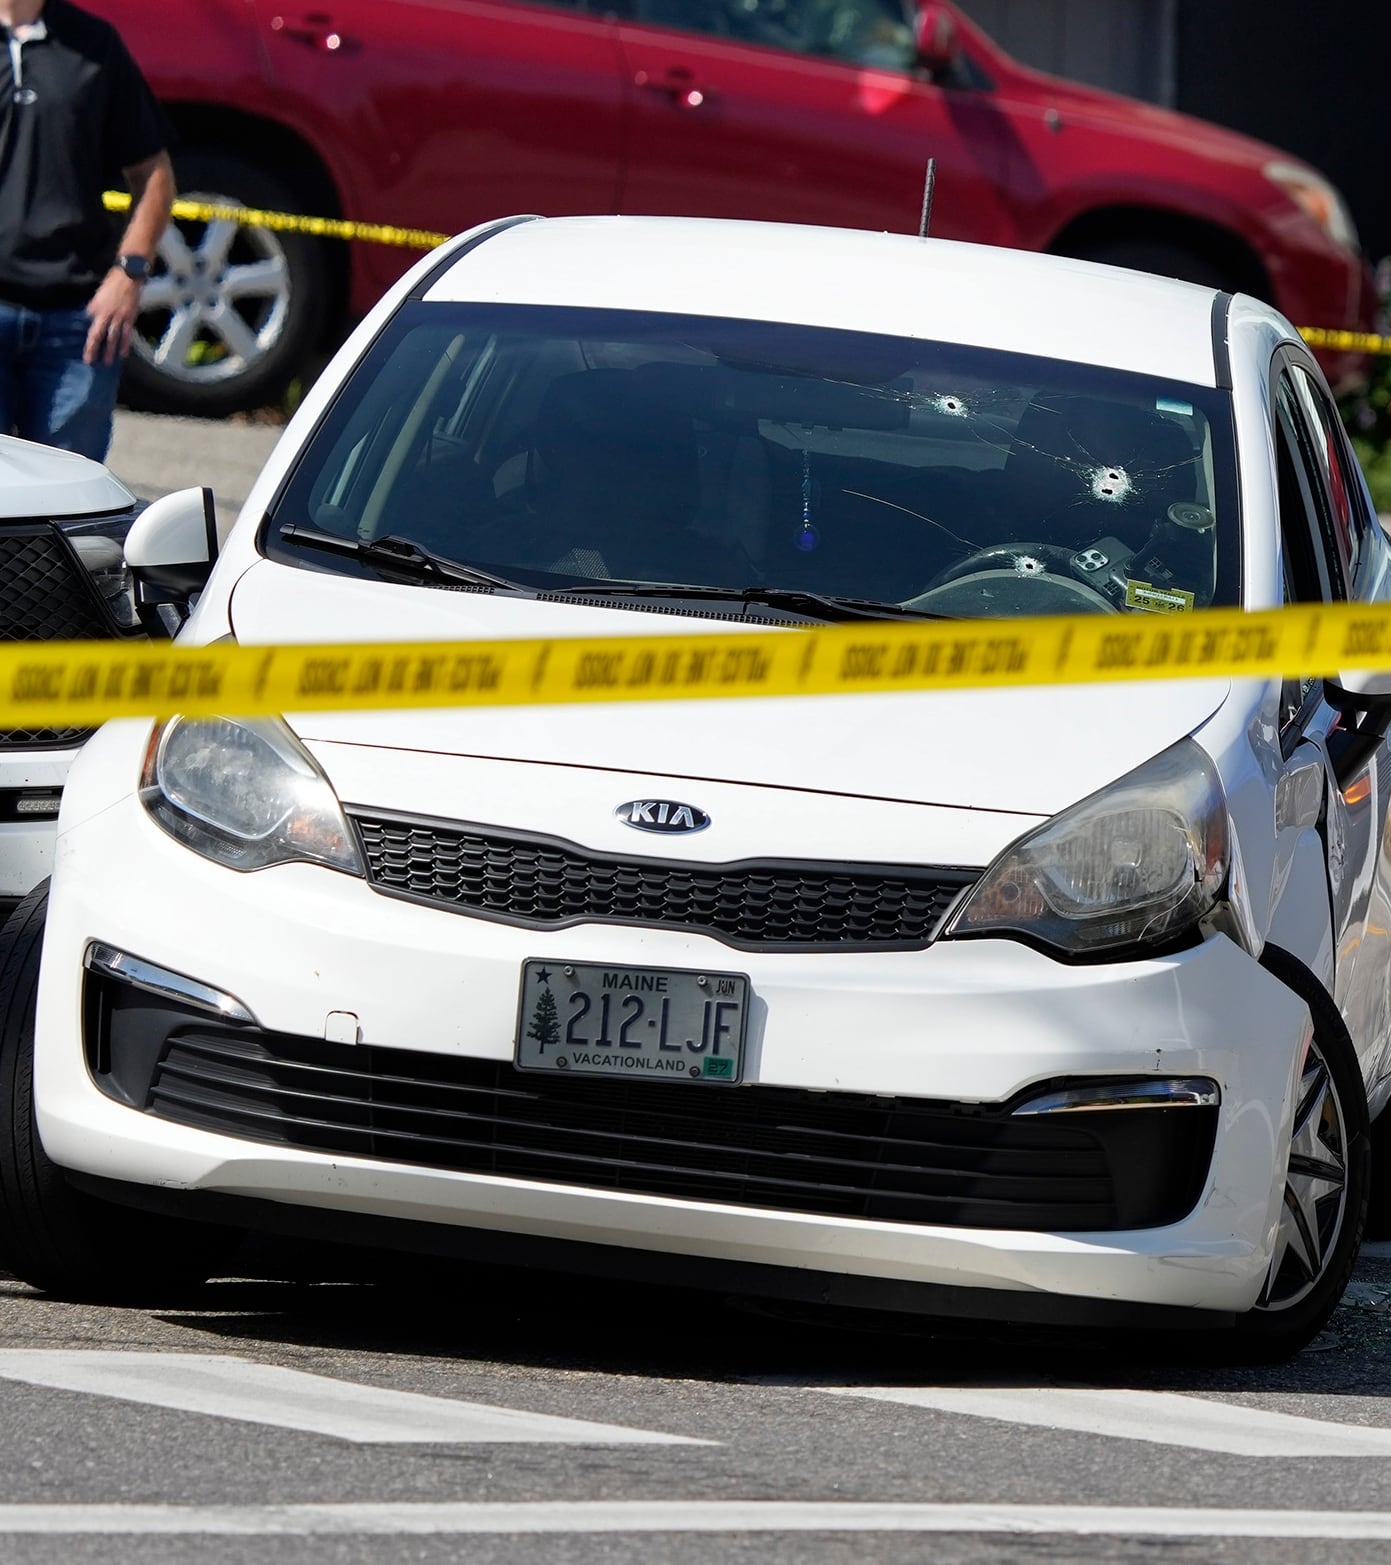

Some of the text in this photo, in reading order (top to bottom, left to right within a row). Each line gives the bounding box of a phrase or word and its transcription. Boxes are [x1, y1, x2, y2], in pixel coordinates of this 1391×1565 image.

[1133, 595, 1150, 605] 25
[1167, 602, 1185, 613] 26
[631, 802, 695, 828] KIA
[602, 972, 668, 993] MAINE
[716, 979, 735, 995] JUN
[572, 1052, 686, 1072] VACATIONLAND
[708, 1059, 729, 1073] 27
